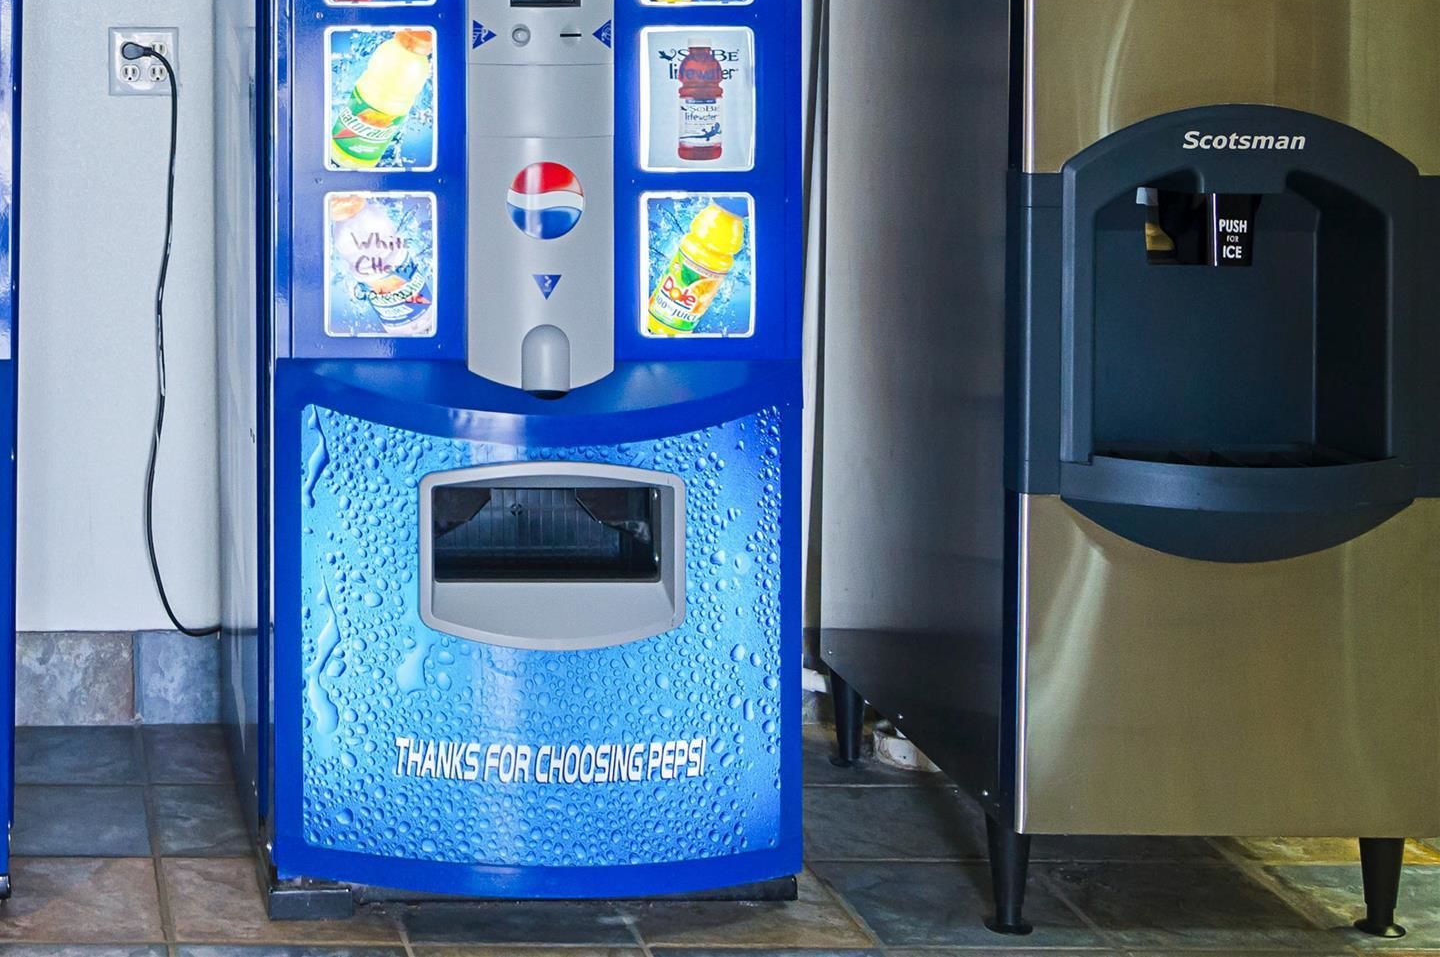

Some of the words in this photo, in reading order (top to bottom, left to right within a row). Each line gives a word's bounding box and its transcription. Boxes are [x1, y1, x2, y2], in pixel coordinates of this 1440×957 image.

[1182, 130, 1306, 150] Scotsman
[1219, 218, 1248, 233] PUSH
[1226, 235, 1239, 243] FOR
[1222, 245, 1242, 259] ICE
[662, 276, 696, 307] Dole
[396, 736, 481, 781] THANKS
[484, 743, 531, 783] FOR
[534, 742, 645, 784] CHOOSING
[646, 738, 706, 781] PEPSI
